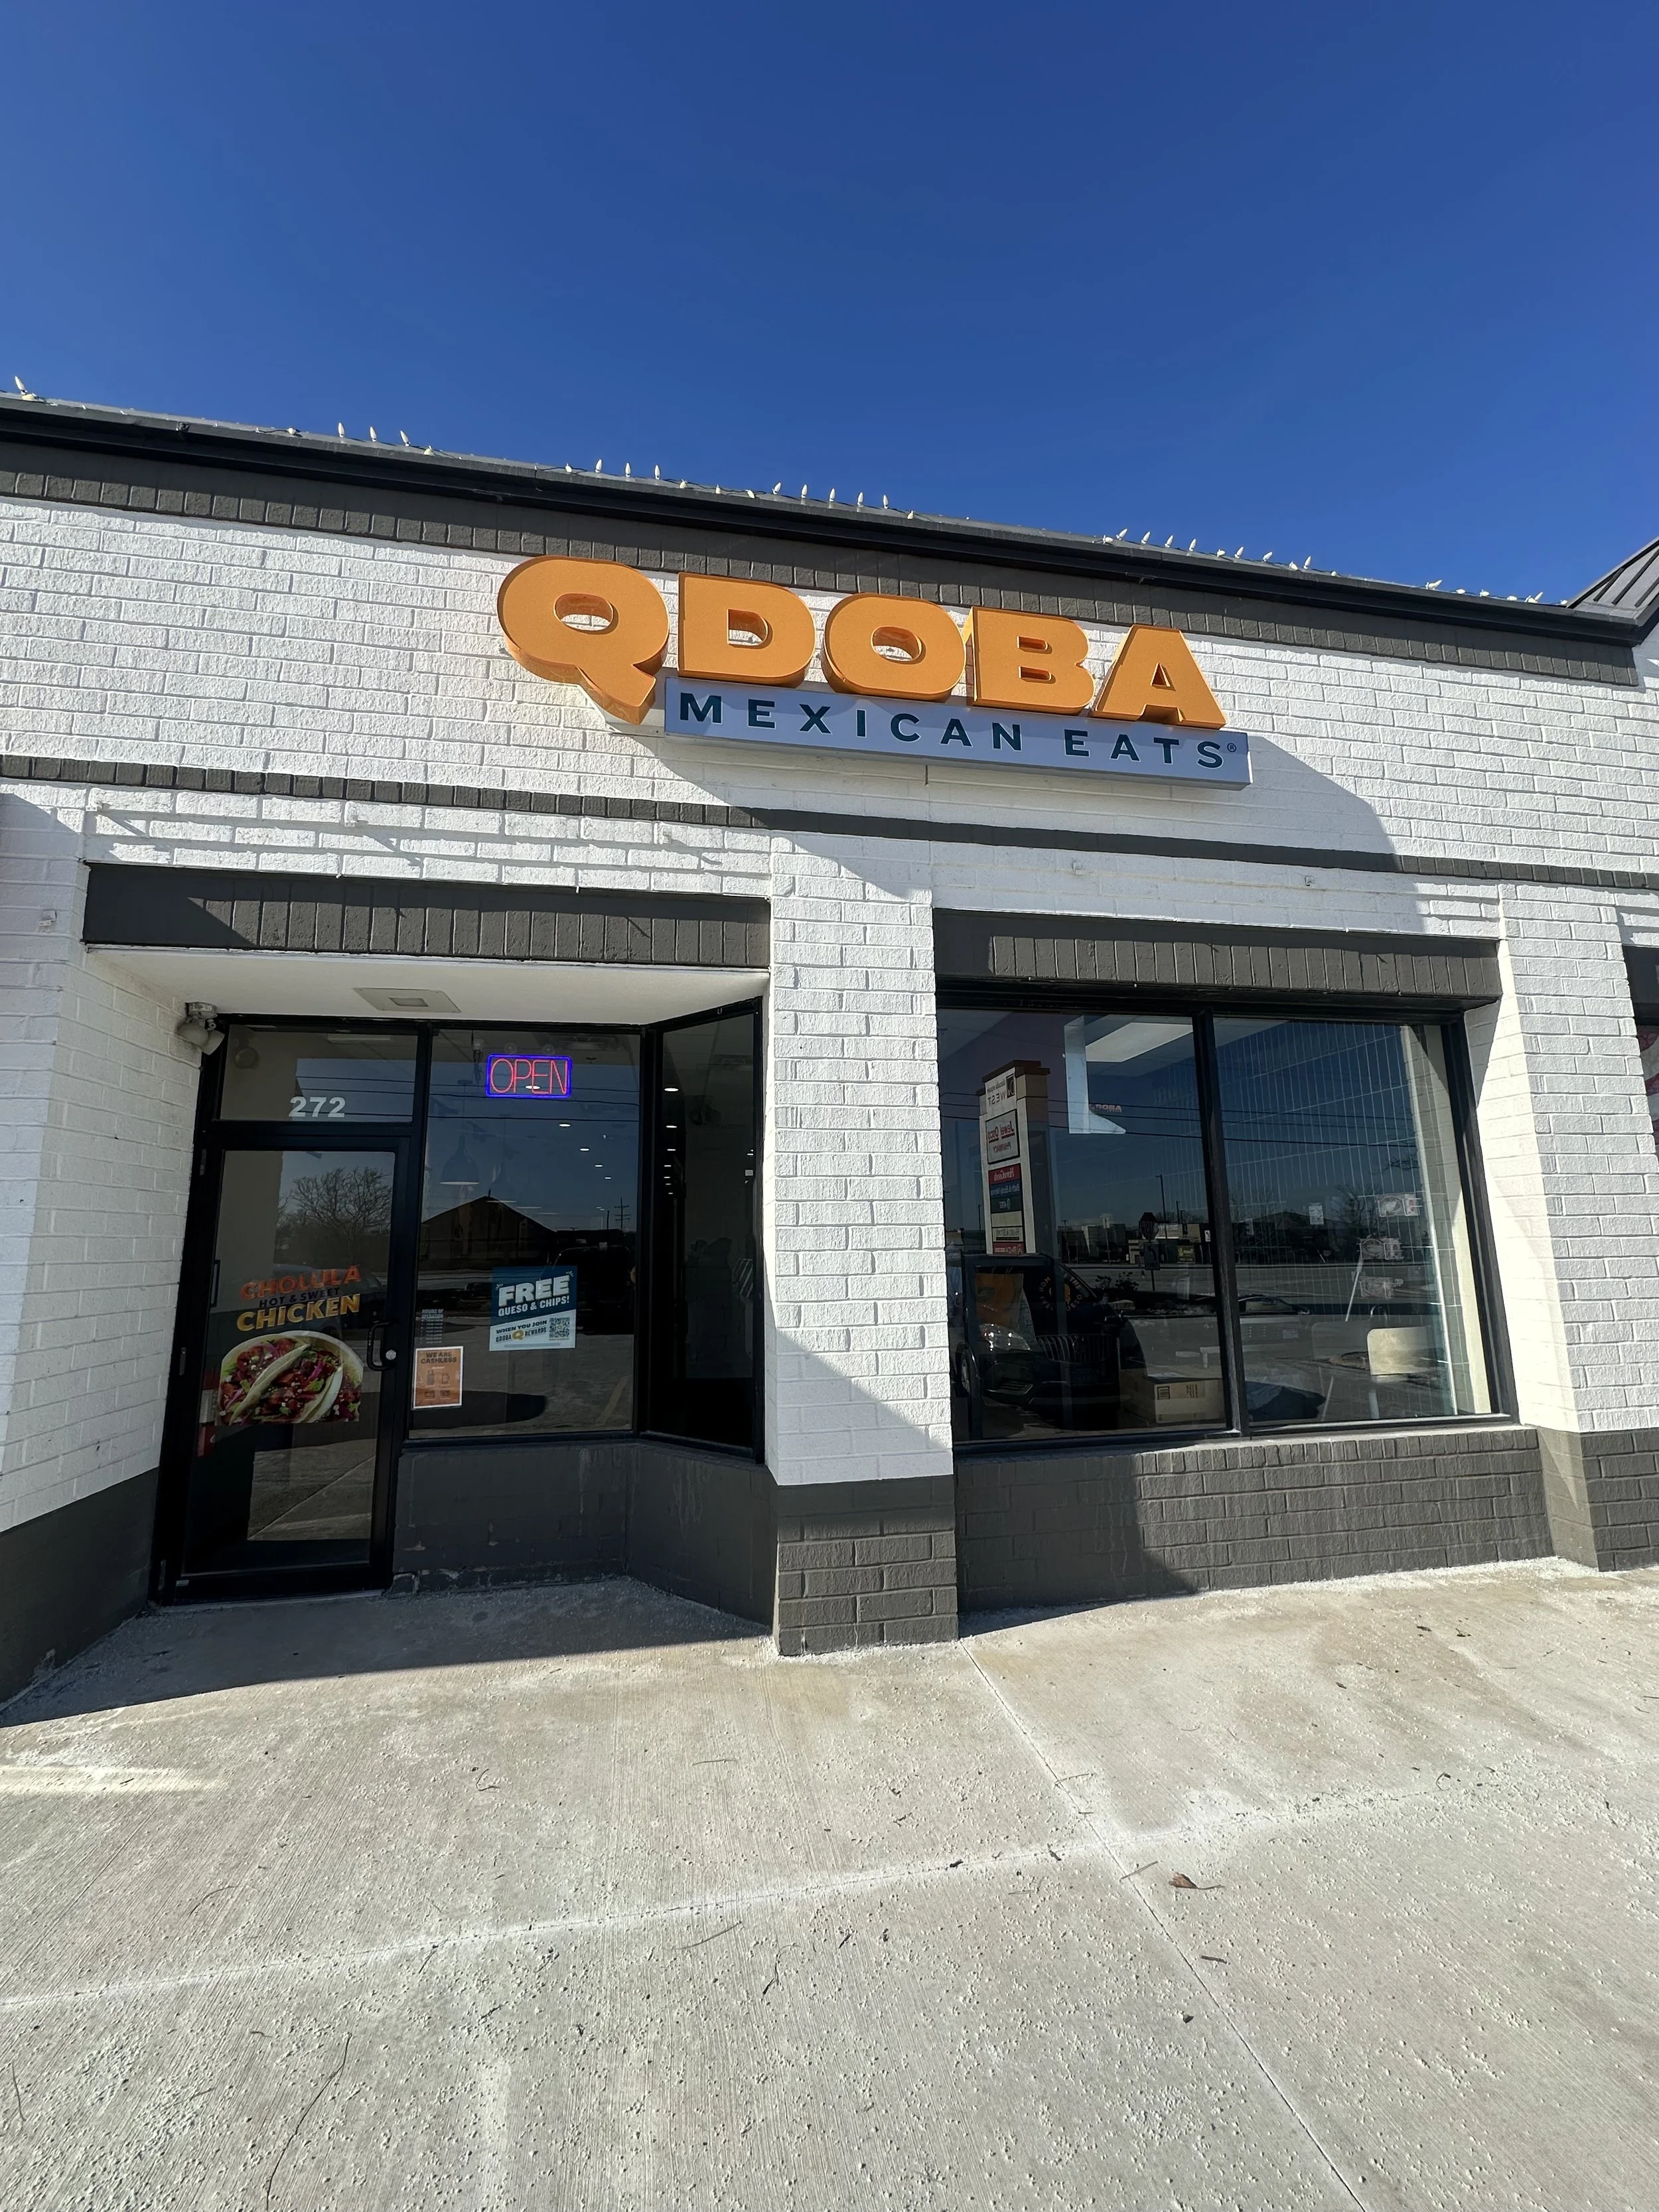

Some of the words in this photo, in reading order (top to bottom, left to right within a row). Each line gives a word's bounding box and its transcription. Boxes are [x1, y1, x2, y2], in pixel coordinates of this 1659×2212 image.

[497, 555, 1226, 729] QDOBA
[678, 692, 1023, 752] MEXICAN
[490, 1057, 569, 1095] OPEN
[289, 1096, 345, 1118] 272
[241, 1264, 362, 1300] CHOLULA
[259, 1295, 286, 1308] HOT
[289, 1294, 297, 1303] &
[300, 1287, 340, 1301] SWEET
[498, 1275, 571, 1307] FREE
[237, 1293, 360, 1331] CHICKEN
[498, 1303, 528, 1317] QUESO
[530, 1301, 538, 1311] &
[540, 1295, 570, 1309] CHIPS!
[525, 1327, 546, 1337] REWARDS
